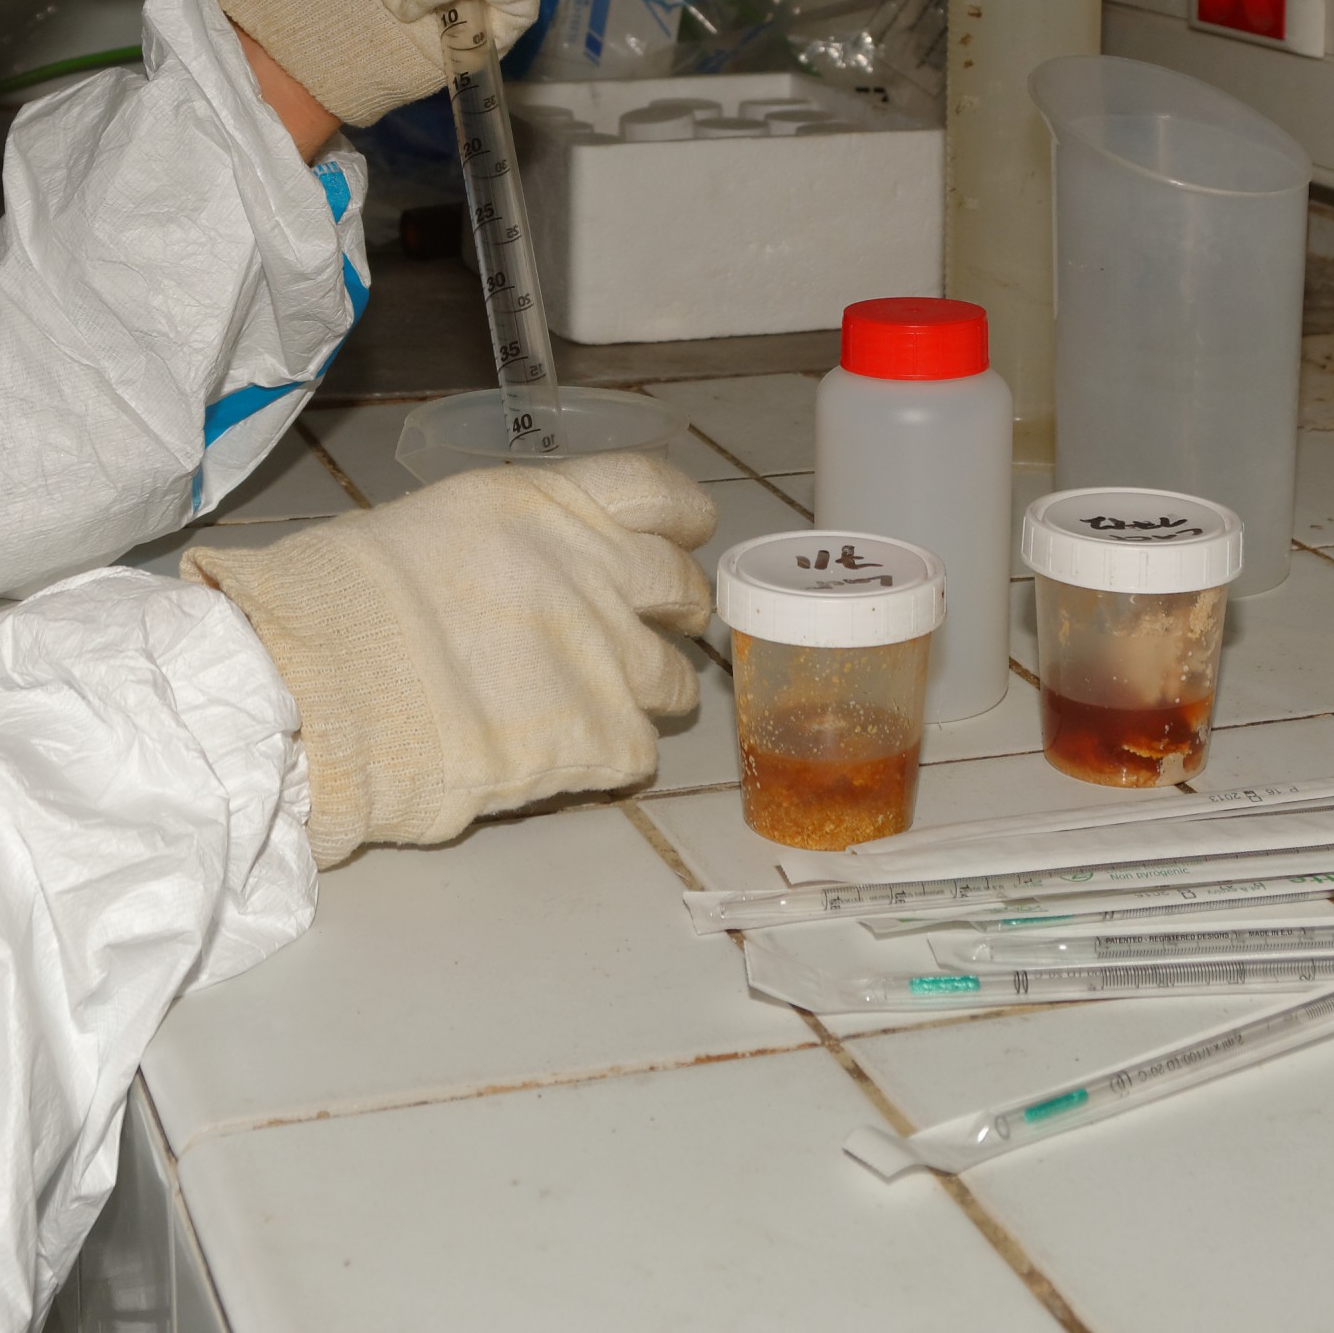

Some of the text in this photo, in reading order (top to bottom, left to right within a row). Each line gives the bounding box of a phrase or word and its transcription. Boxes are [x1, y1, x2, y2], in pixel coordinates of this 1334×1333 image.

[440, 9, 459, 28] 10
[451, 71, 472, 91] 15
[462, 137, 482, 157] 20
[474, 202, 495, 223] 25
[485, 272, 506, 293] 30
[499, 341, 521, 362] 35
[511, 414, 533, 435] 40
[1209, 792, 1242, 803] 2013
[1110, 866, 1191, 881] Non pyrogenic
[1105, 936, 1143, 945] PATENTED
[1149, 933, 1196, 943] REGISTERED
[1197, 931, 1230, 941] DESIGNS
[1248, 929, 1270, 938] MADE
